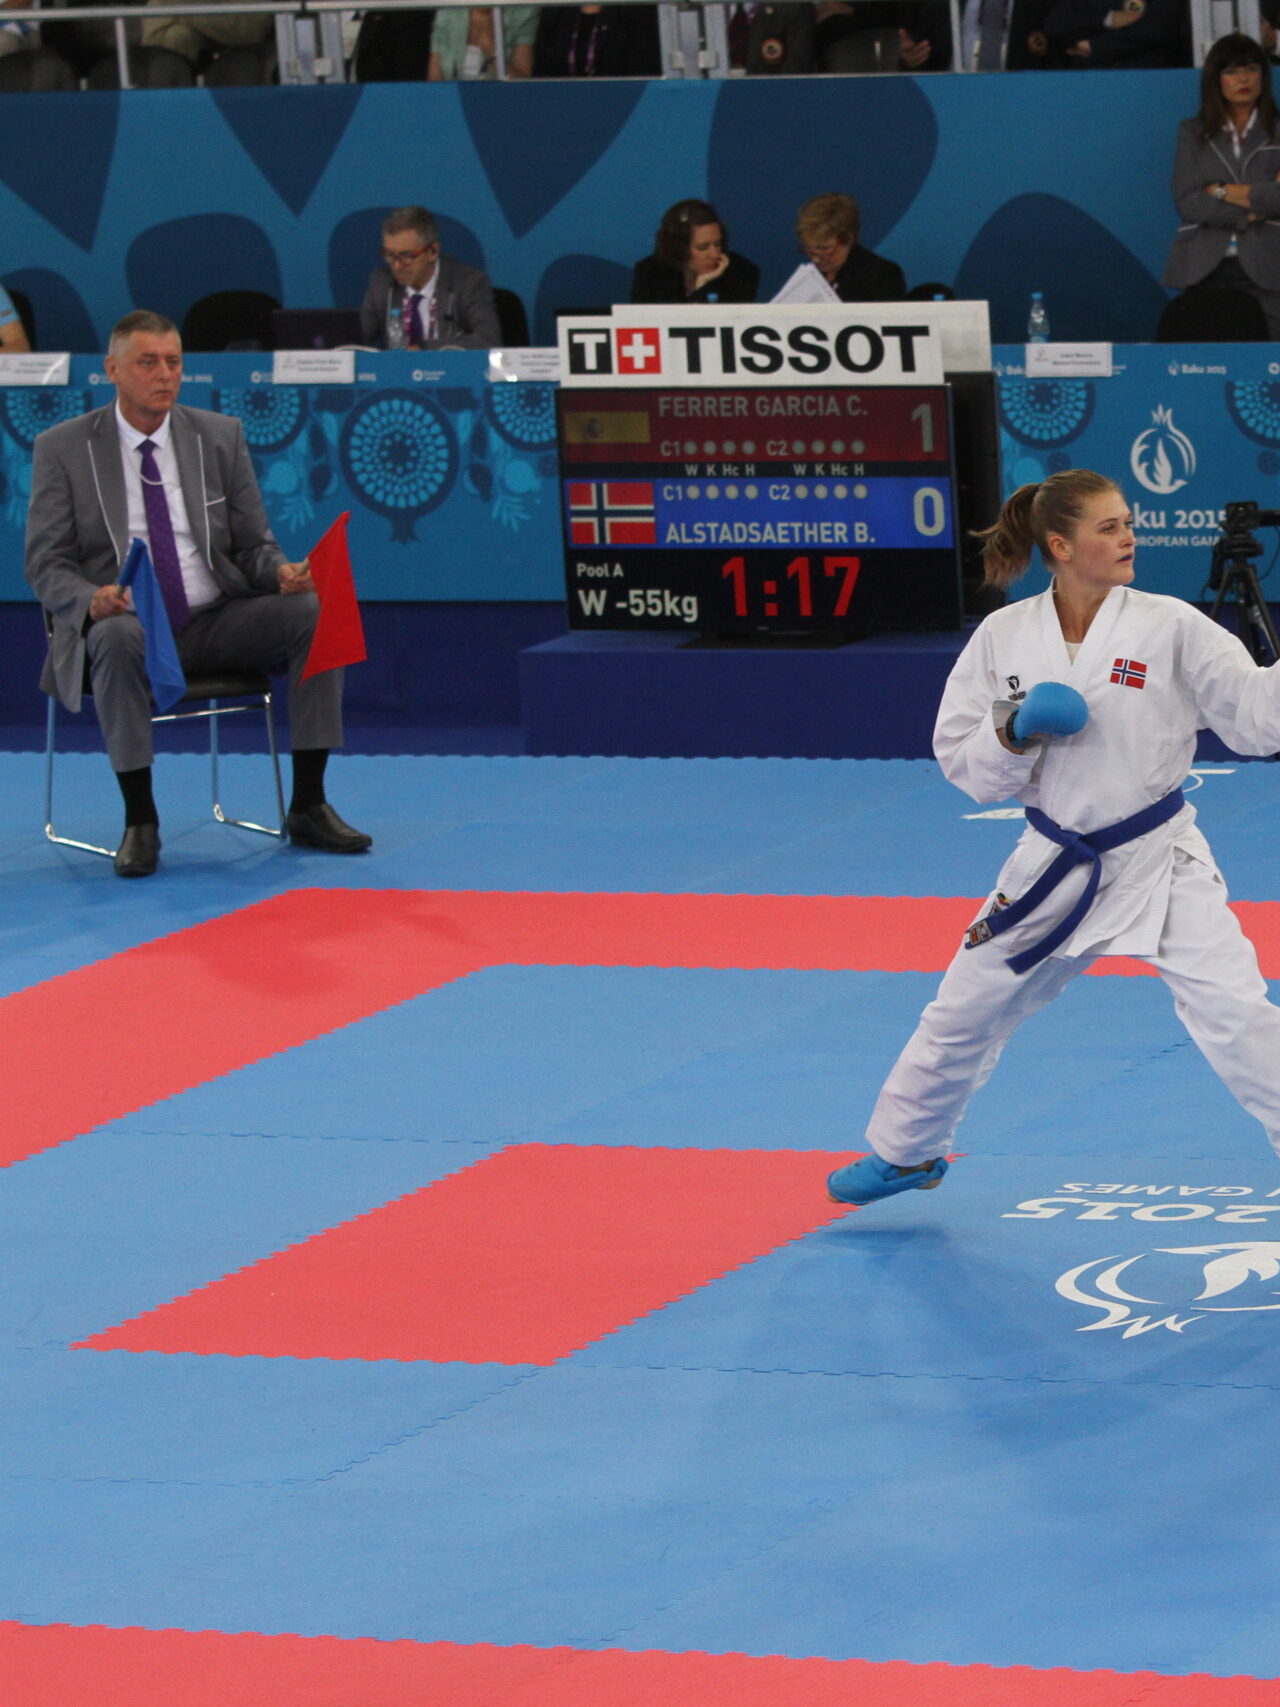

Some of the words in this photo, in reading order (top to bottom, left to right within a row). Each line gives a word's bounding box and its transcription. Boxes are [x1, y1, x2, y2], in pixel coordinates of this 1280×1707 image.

[669, 325, 929, 374] TISSOT
[1182, 364, 1204, 374] Baku
[658, 396, 749, 418] FERRER
[755, 394, 841, 417] GARCIA
[846, 394, 869, 415] C.
[911, 403, 934, 453] 1
[660, 441, 681, 456] C1
[766, 440, 788, 456] C2
[685, 465, 698, 476] W
[706, 465, 716, 476] K
[745, 465, 755, 476] H
[794, 465, 807, 476] W
[815, 464, 825, 476] K
[854, 464, 864, 476] H
[663, 485, 683, 501] C1
[769, 485, 791, 501] C2
[913, 487, 945, 537] 0
[1132, 502, 1166, 529] ku
[665, 522, 849, 544] ALSTADSAETHER
[854, 521, 876, 544] B.
[576, 563, 610, 578] Pool
[613, 562, 624, 578] A
[721, 555, 861, 617] 1:17
[577, 589, 607, 617] W
[615, 588, 699, 623] -55kg
[1054, 1182, 1254, 1197] GAMES
